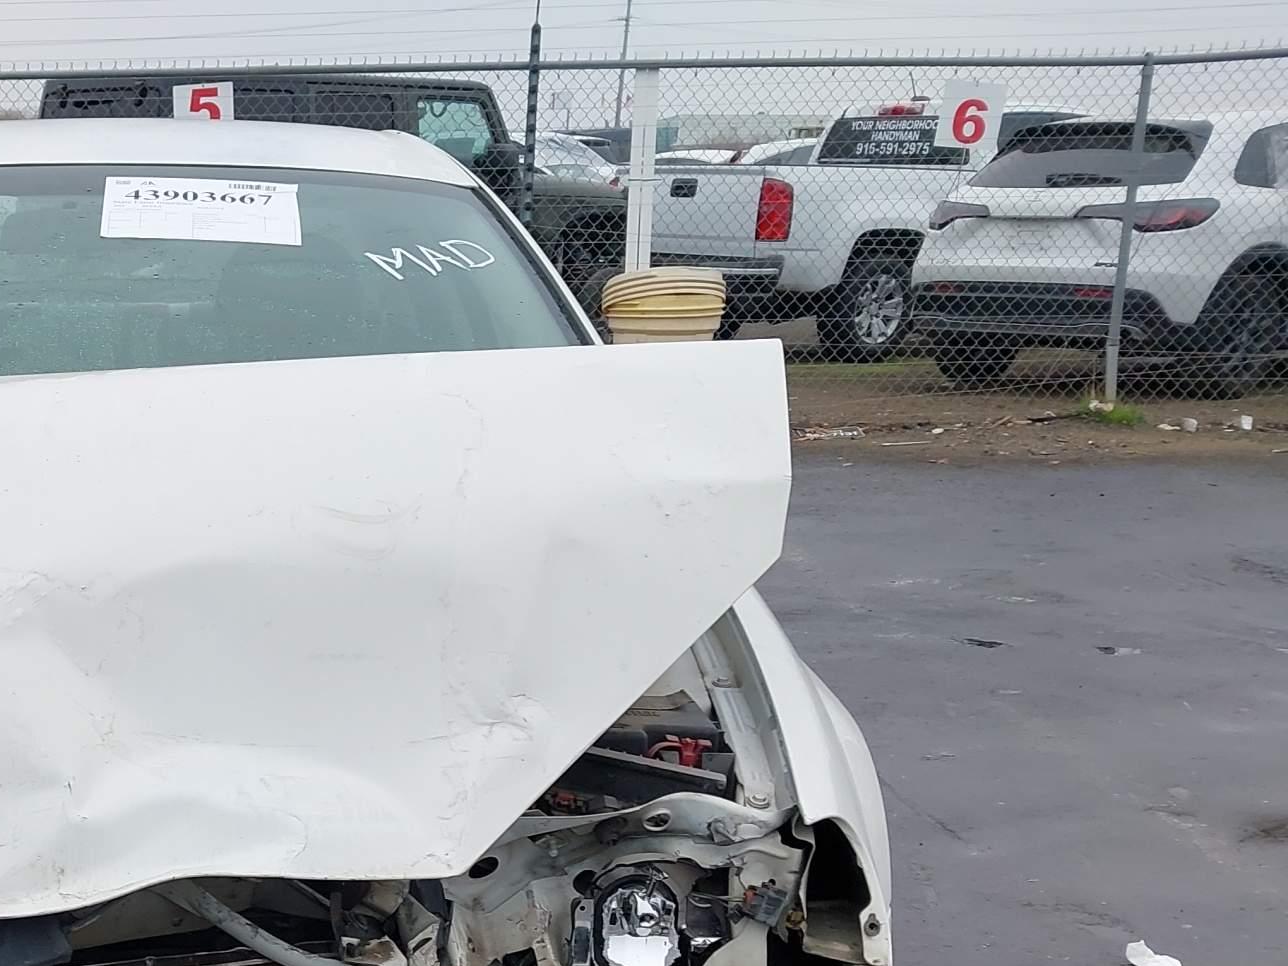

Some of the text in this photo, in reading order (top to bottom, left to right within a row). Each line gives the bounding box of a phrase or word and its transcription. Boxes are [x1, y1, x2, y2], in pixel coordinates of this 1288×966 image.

[189, 87, 221, 120] 5
[851, 119, 939, 130] YOUR NEIGHBORHOO
[951, 98, 989, 145] 6
[871, 130, 920, 141] HANDYMAN
[124, 188, 273, 206] 43903667
[363, 239, 496, 281] MAD
